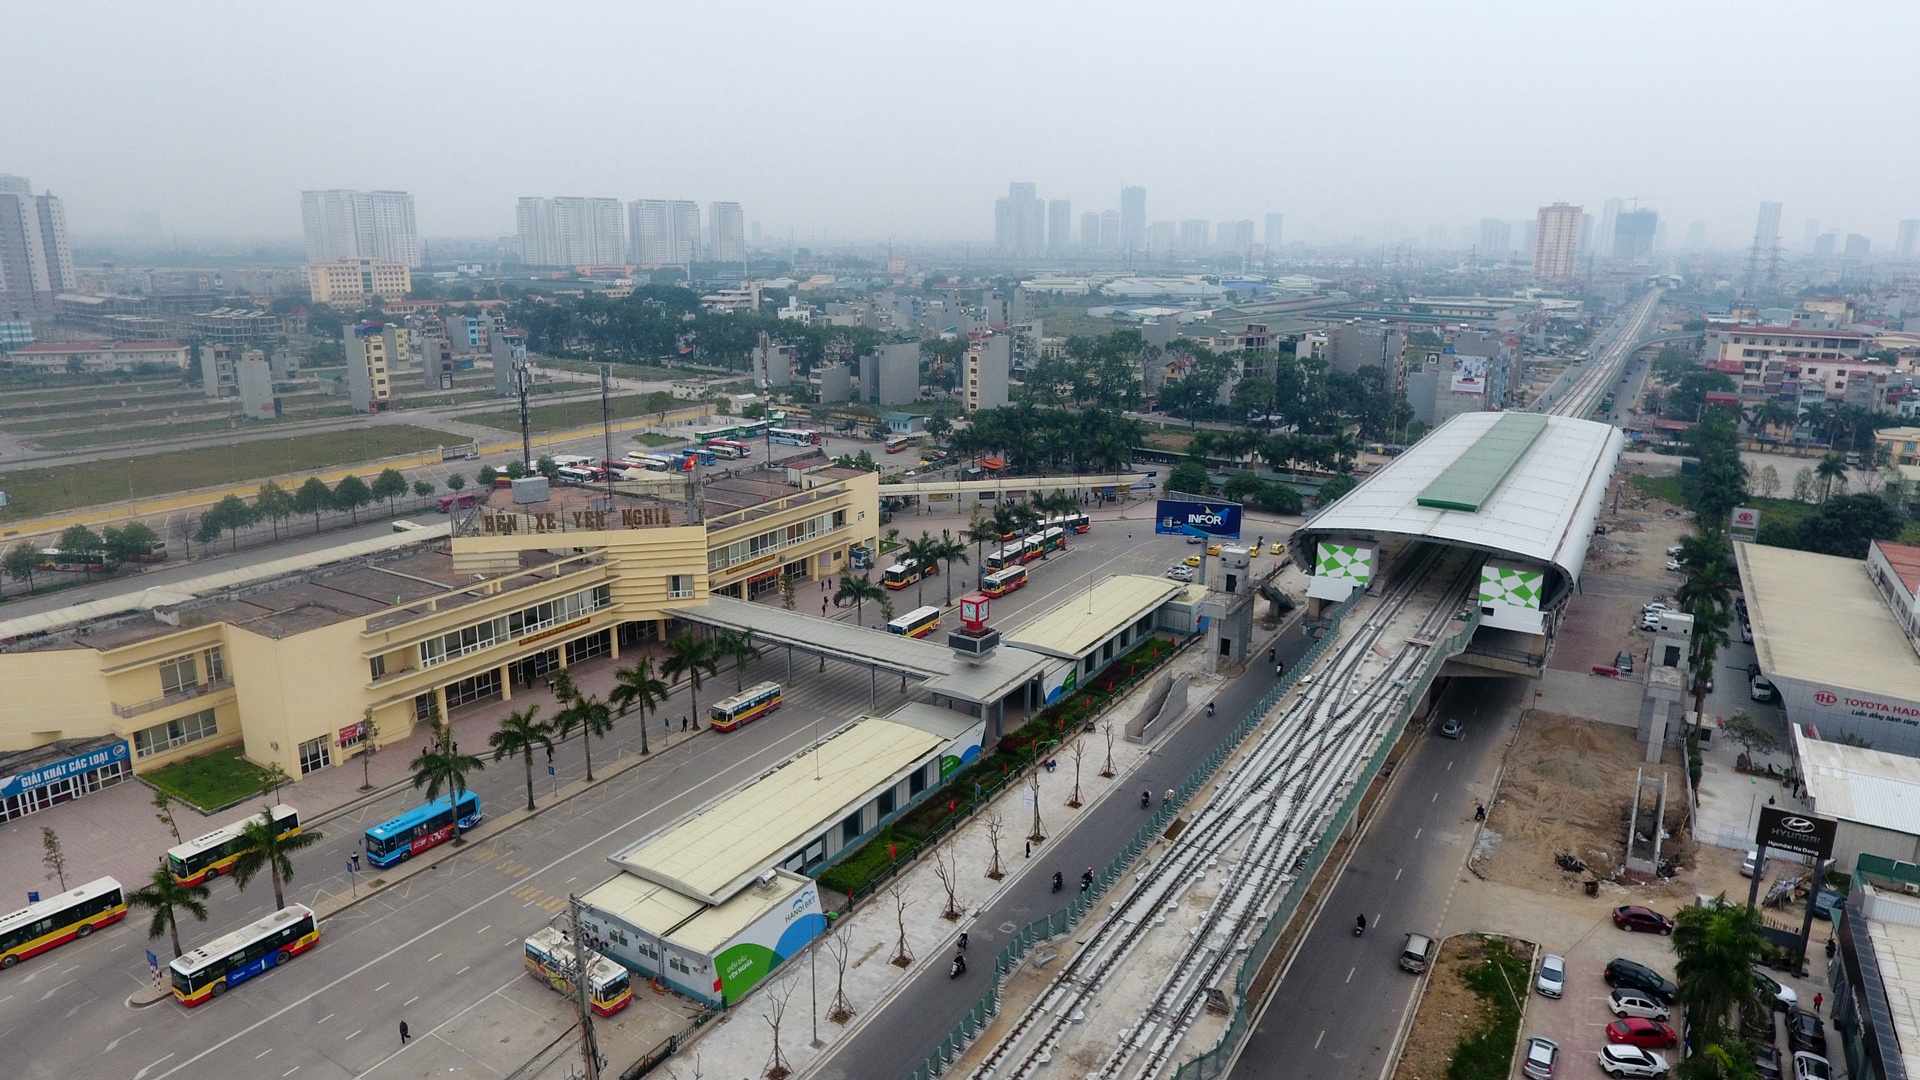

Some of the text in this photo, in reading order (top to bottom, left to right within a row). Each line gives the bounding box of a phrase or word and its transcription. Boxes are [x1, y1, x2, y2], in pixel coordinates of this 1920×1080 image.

[535, 513, 556, 530] XE
[1188, 513, 1222, 526] INFOR
[1844, 697, 1920, 717] TOYOTA HAD
[43, 764, 67, 781] KHÁT
[68, 758, 88, 773] CÁC
[88, 751, 109, 765] LOẠI
[1771, 827, 1821, 844] HYUNDAI
[1767, 840, 1793, 850] Hyundai
[1802, 847, 1819, 856] Dong
[784, 896, 816, 922] HANOI BRT
